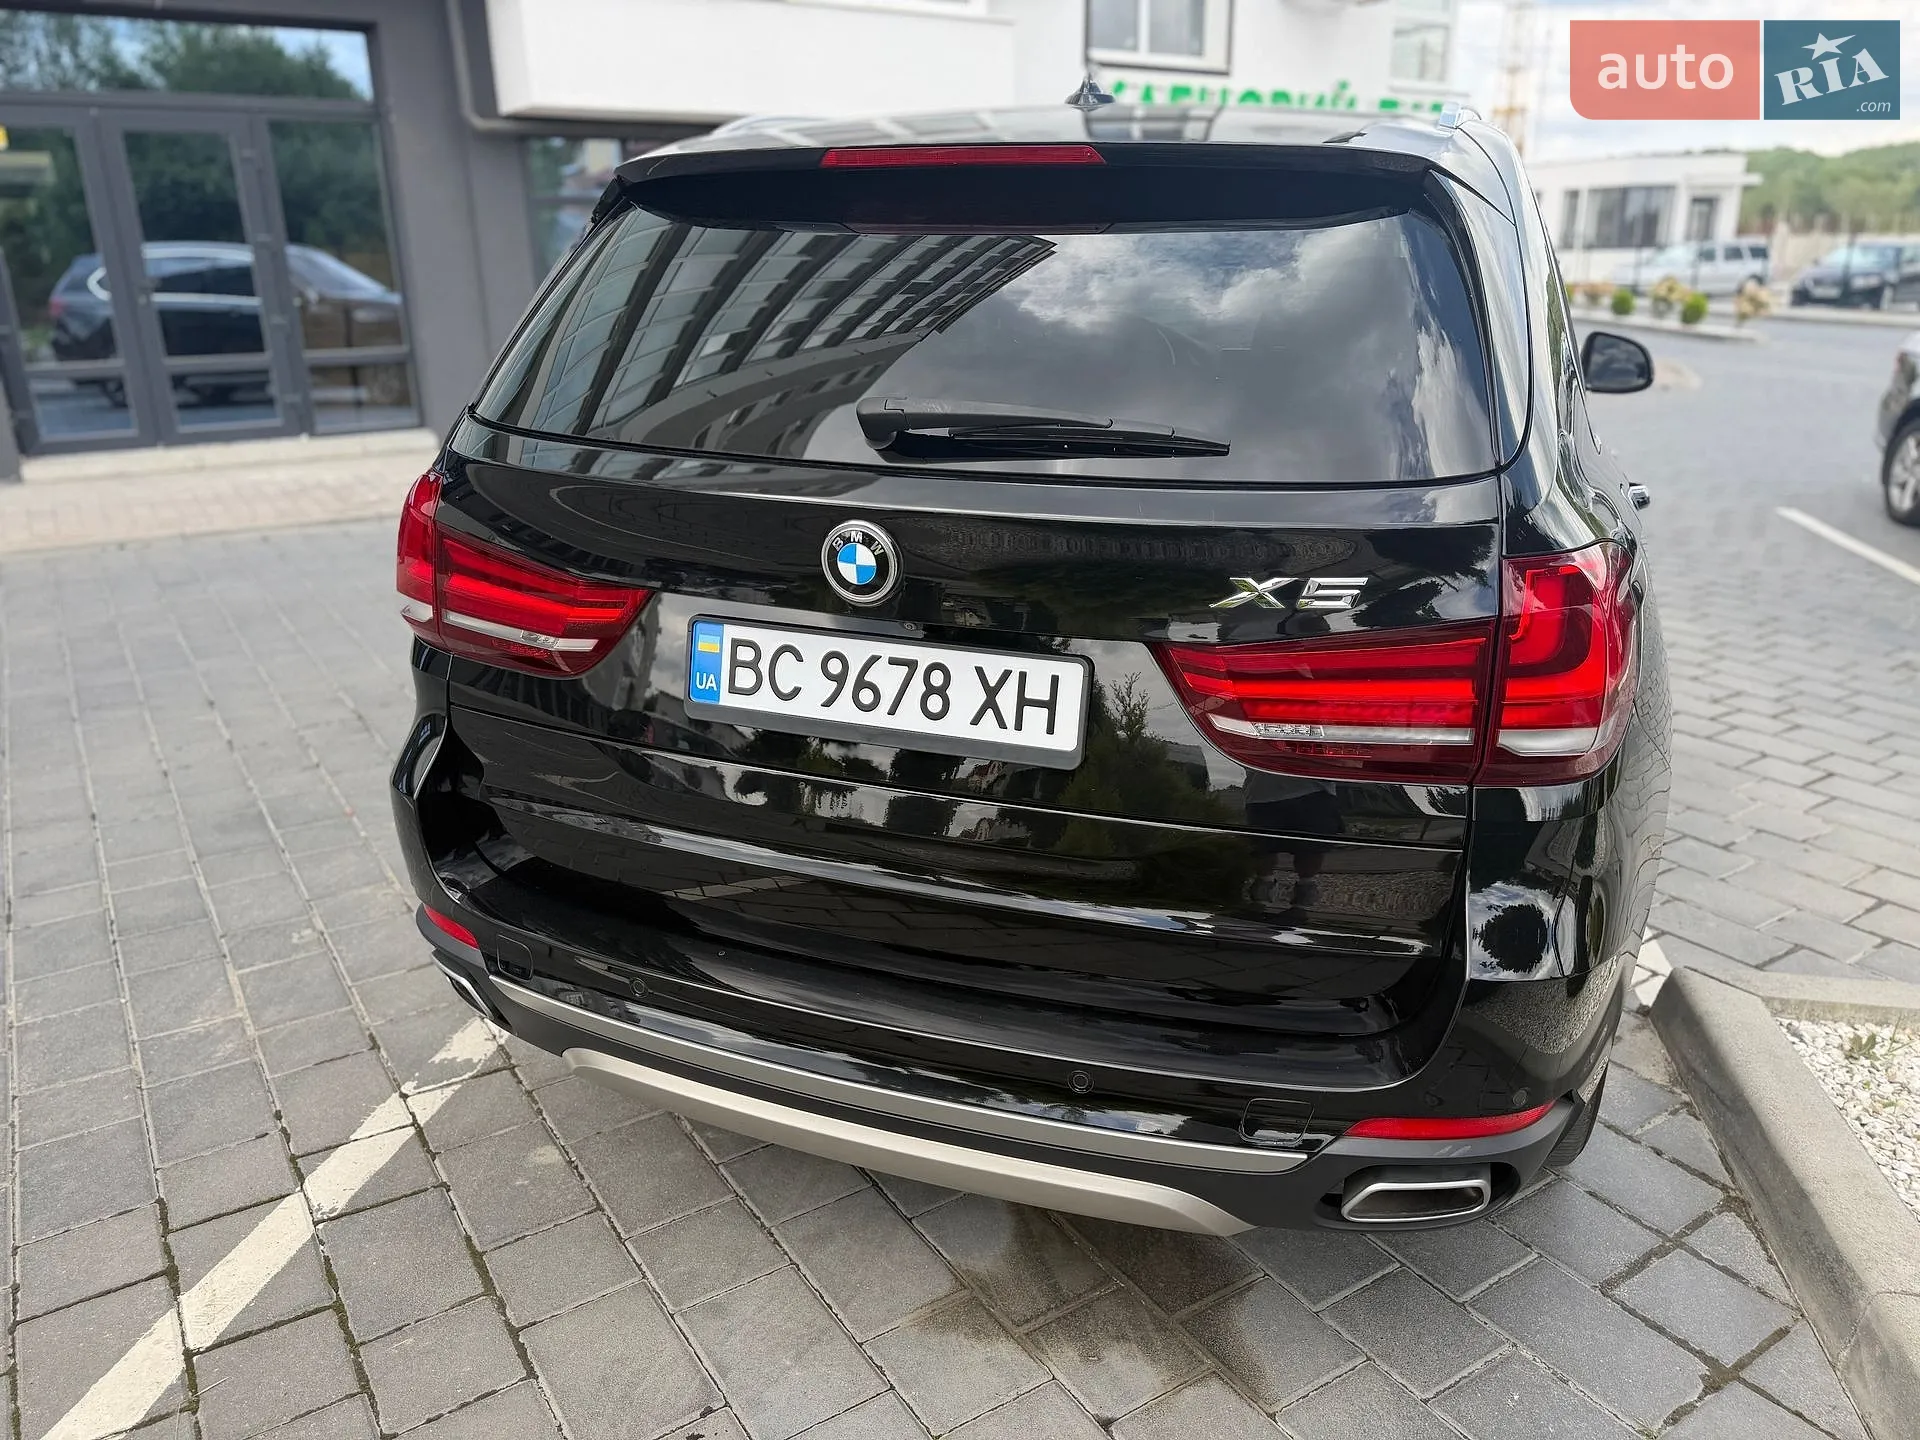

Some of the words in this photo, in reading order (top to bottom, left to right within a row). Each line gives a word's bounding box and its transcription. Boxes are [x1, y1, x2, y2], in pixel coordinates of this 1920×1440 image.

[831, 530, 885, 557] BMW
[1208, 576, 1370, 609] X5
[695, 671, 718, 692] UA
[727, 637, 805, 702] BC
[819, 649, 953, 722] 9678
[969, 664, 1060, 736] XH
